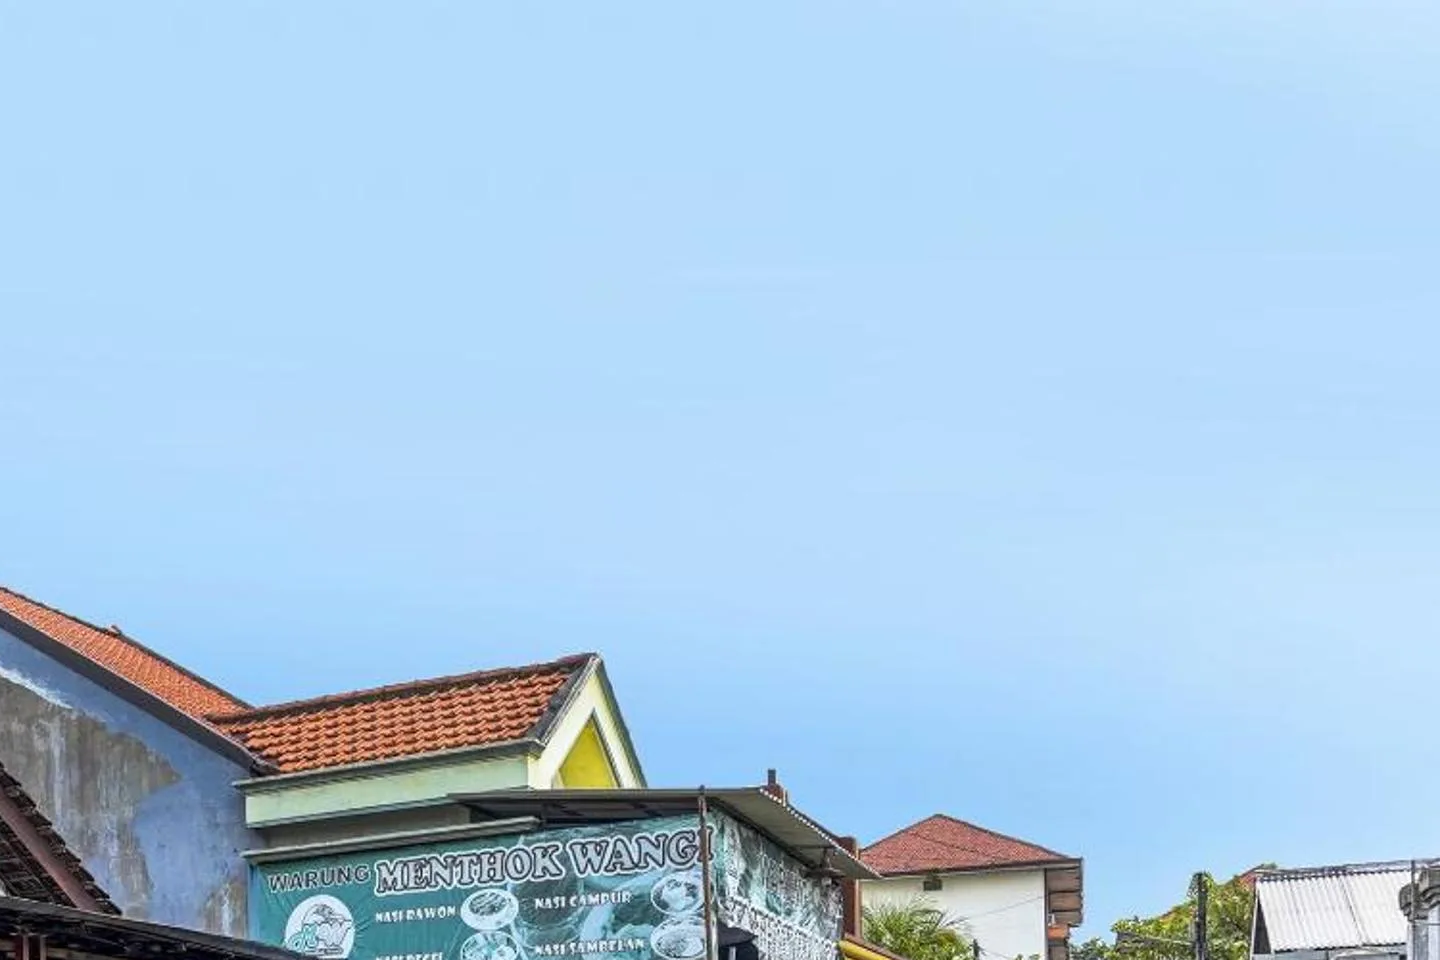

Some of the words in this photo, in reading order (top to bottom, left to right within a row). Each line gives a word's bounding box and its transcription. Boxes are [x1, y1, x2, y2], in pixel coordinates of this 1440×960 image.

[270, 865, 369, 892] WARUNG
[375, 843, 564, 895] MENTHOK
[535, 896, 566, 910] NASI
[569, 889, 634, 908] CAMPUR
[375, 909, 403, 923] NASI
[406, 904, 457, 921] RAWON
[536, 943, 566, 957] NASI
